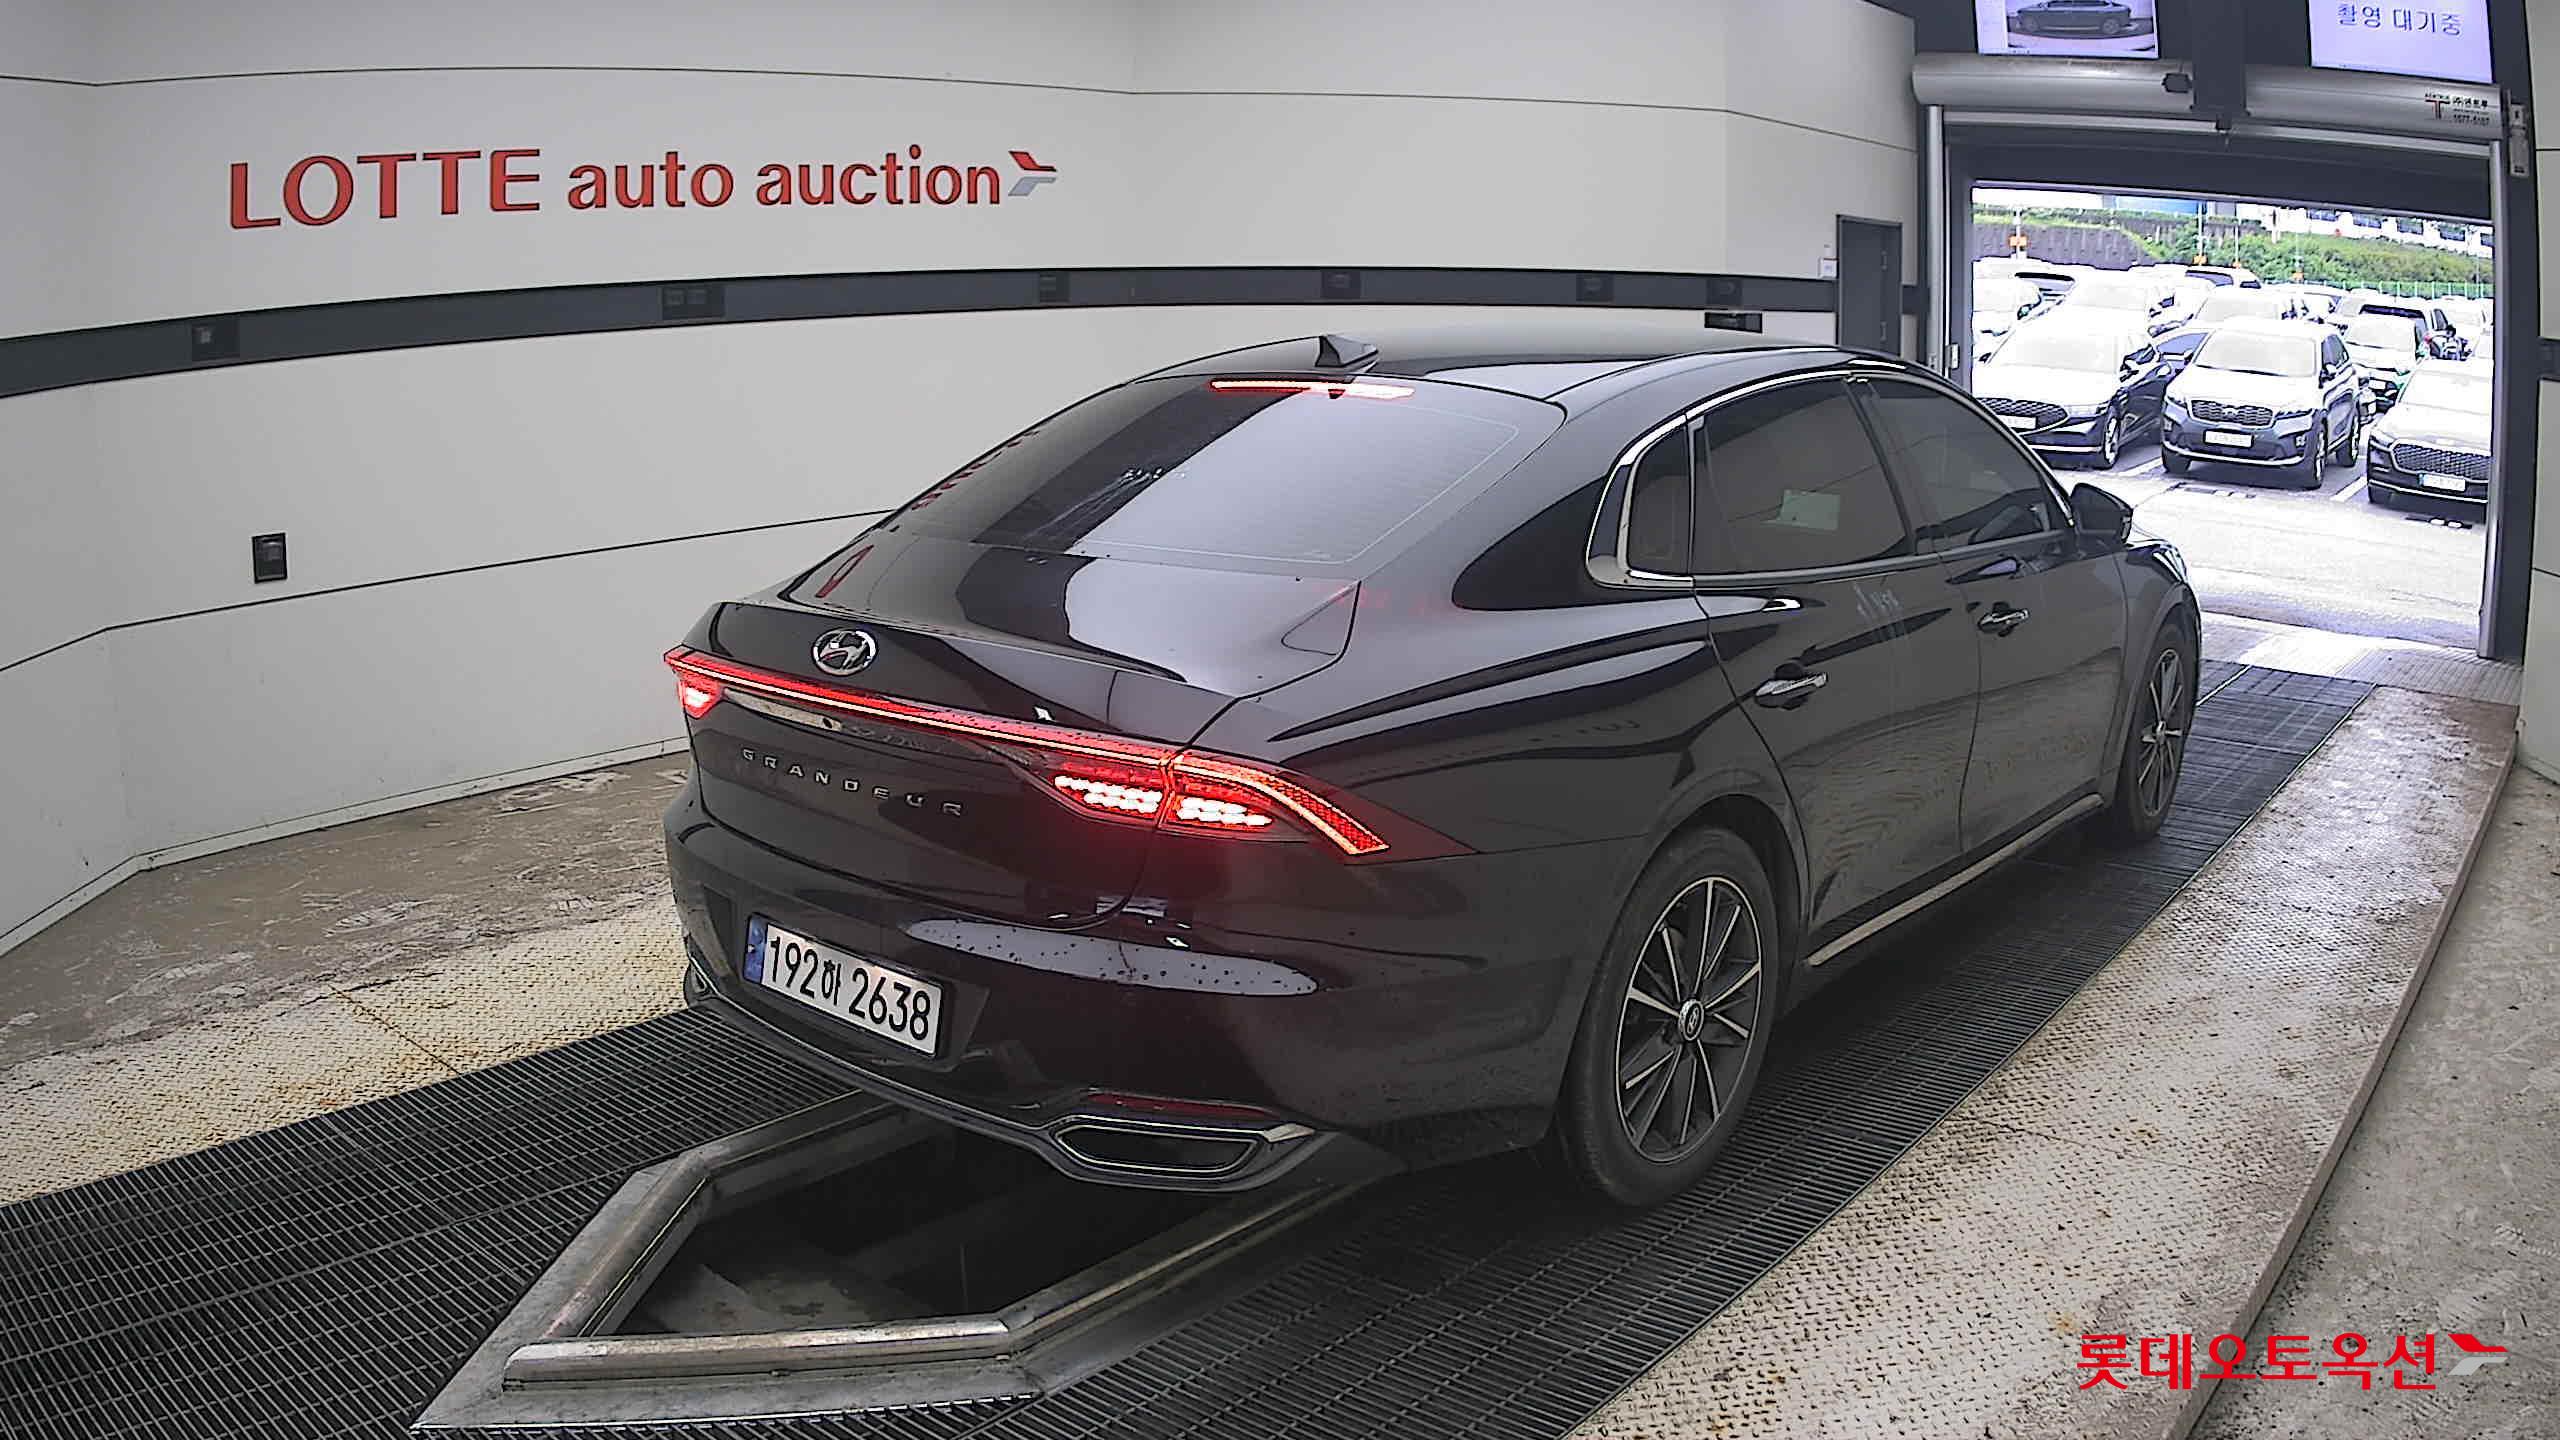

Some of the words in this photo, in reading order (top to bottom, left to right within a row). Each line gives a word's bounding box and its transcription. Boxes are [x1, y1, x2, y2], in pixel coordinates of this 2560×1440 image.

[2338, 4, 2382, 29] 촬영
[2393, 8, 2461, 36] 대기중
[229, 148, 541, 229] LOTTE
[567, 151, 734, 209] auto
[755, 144, 1002, 206] auction
[743, 748, 962, 816] GRANDEUR
[770, 936, 842, 1006] 192하
[848, 967, 931, 1041] 2638
